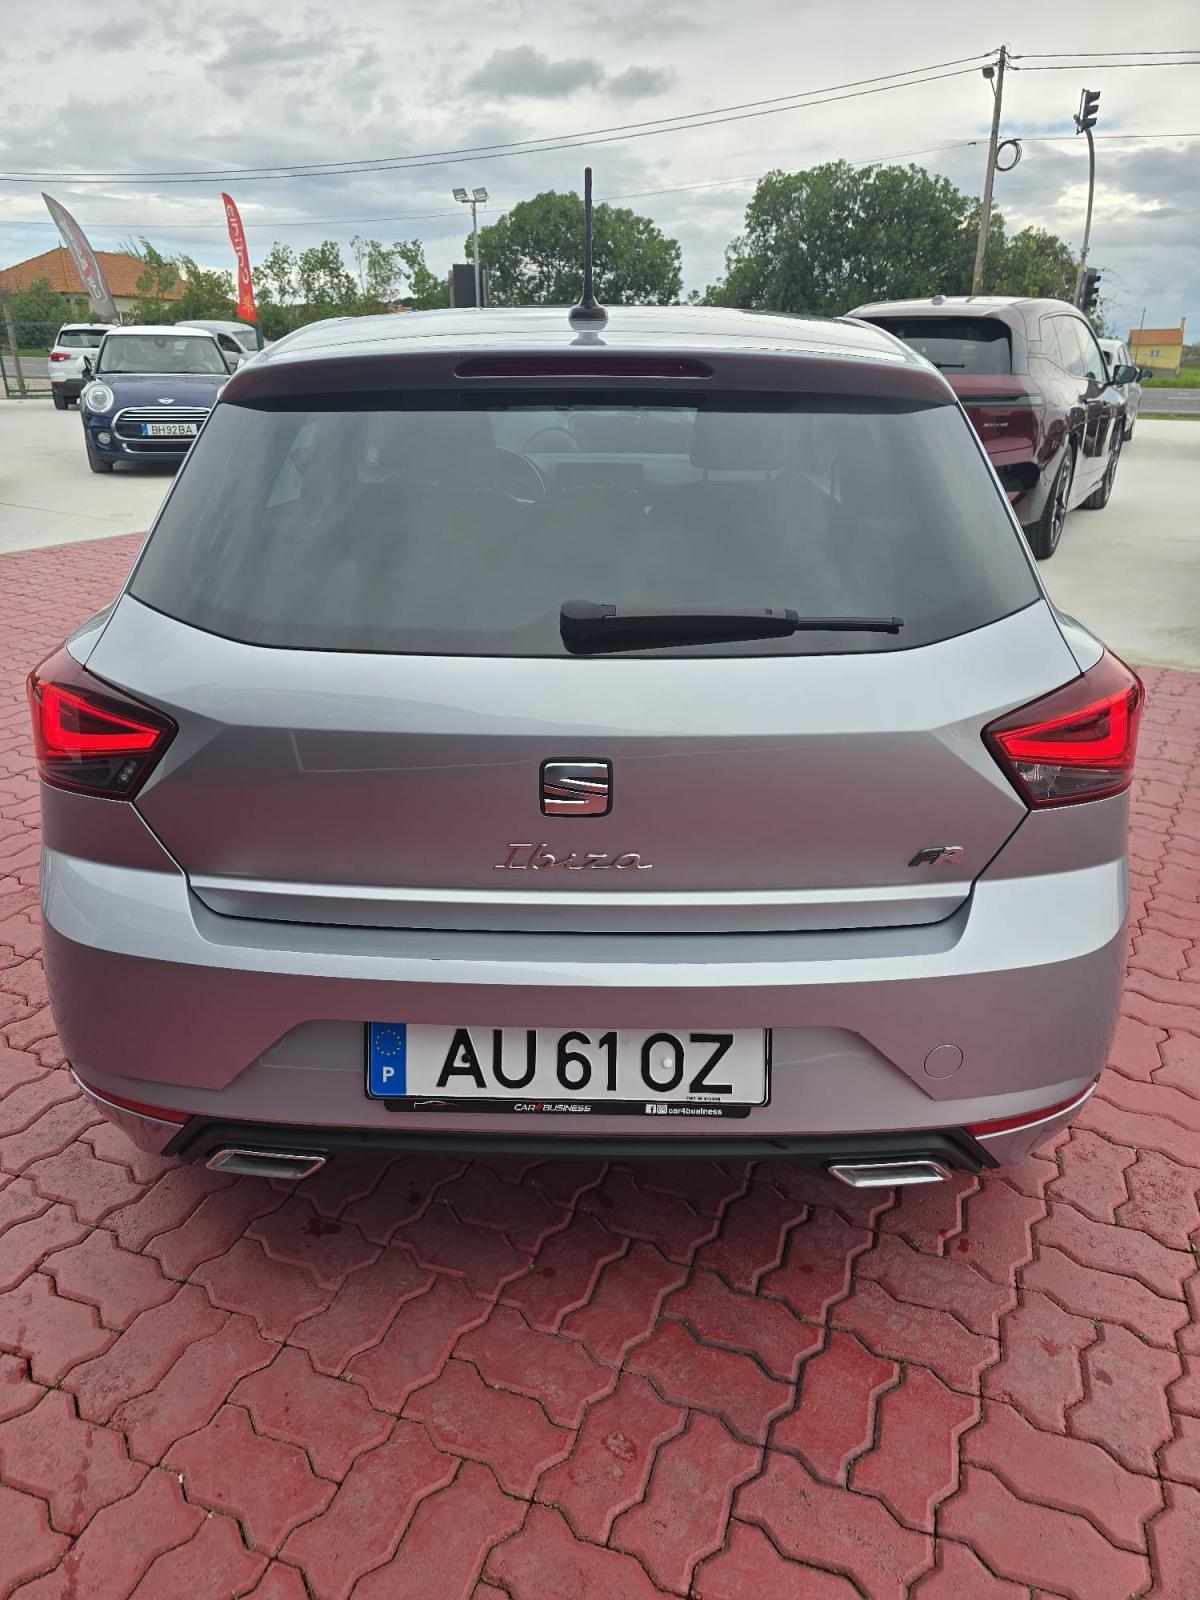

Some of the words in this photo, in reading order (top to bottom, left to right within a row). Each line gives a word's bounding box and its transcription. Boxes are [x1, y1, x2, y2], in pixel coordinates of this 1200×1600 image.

[493, 841, 653, 870] Ibiza
[382, 1066, 395, 1083] P
[436, 1028, 537, 1089] AU
[556, 1031, 617, 1091] 61
[641, 1032, 734, 1094] OZ
